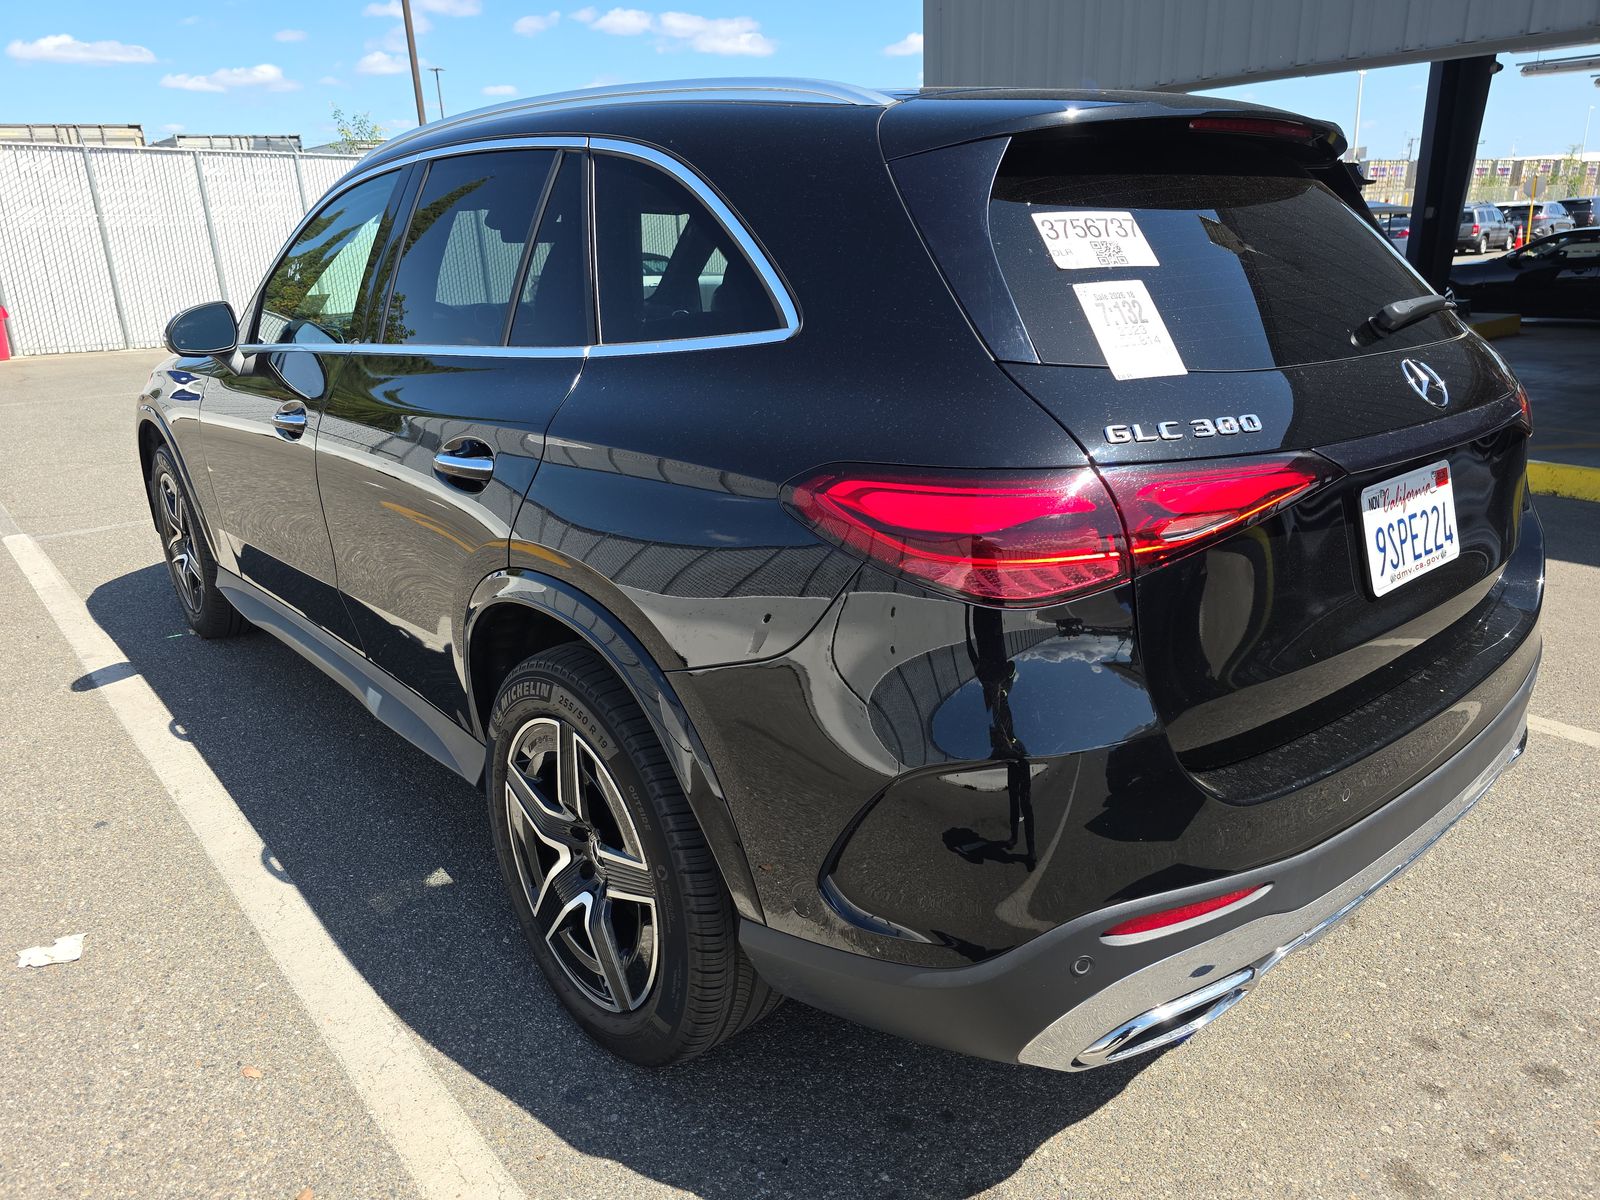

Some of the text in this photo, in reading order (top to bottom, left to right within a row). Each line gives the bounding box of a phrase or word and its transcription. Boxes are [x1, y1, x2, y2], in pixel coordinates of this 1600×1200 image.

[1041, 218, 1137, 240] 3756737
[1103, 414, 1263, 444] GLC 300
[1383, 479, 1437, 514] California
[1376, 501, 1453, 577] 9SPE224
[1396, 554, 1440, 580] dmv.ca.gov
[501, 681, 550, 709] MICHELIN
[558, 695, 609, 750] 255/50 R 19
